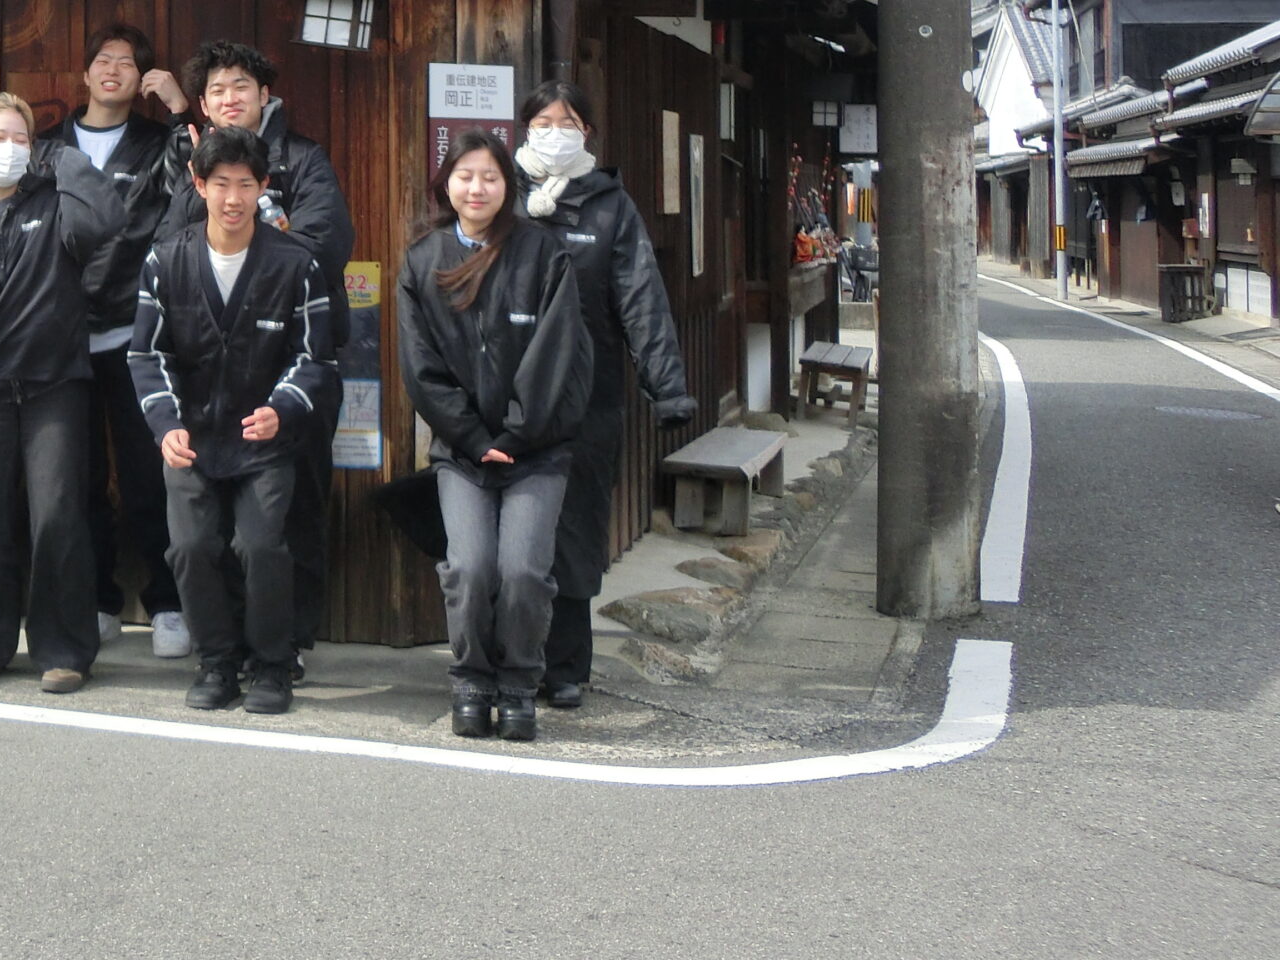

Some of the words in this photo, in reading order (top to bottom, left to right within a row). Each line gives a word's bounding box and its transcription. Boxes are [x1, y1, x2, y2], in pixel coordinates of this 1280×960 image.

[446, 74, 497, 88] 重伝建地区
[445, 90, 473, 107] 岡正
